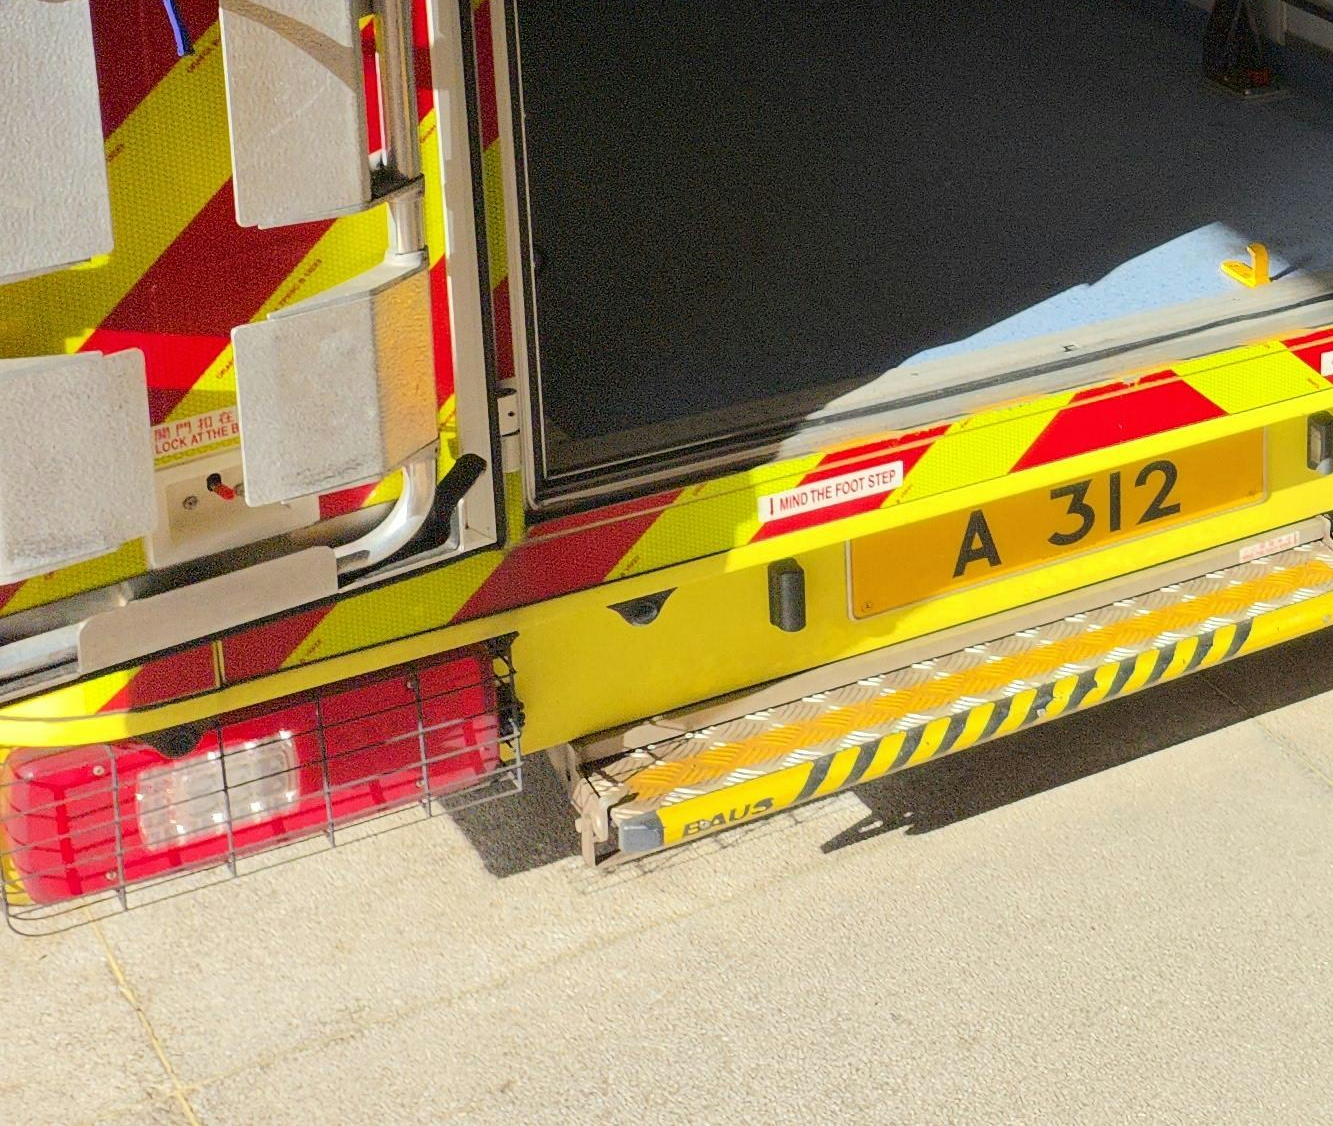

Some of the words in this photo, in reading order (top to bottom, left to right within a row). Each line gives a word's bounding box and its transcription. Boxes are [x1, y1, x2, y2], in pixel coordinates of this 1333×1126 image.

[155, 436, 187, 455] LOCK
[191, 430, 203, 446] AT
[206, 425, 228, 441] THE
[780, 492, 808, 512] MIND
[810, 485, 832, 504] THE
[836, 477, 865, 497] FOOT
[868, 469, 896, 489] STEP
[953, 509, 1002, 579] A
[1048, 460, 1181, 547] 312
[683, 797, 775, 838] BAUS
